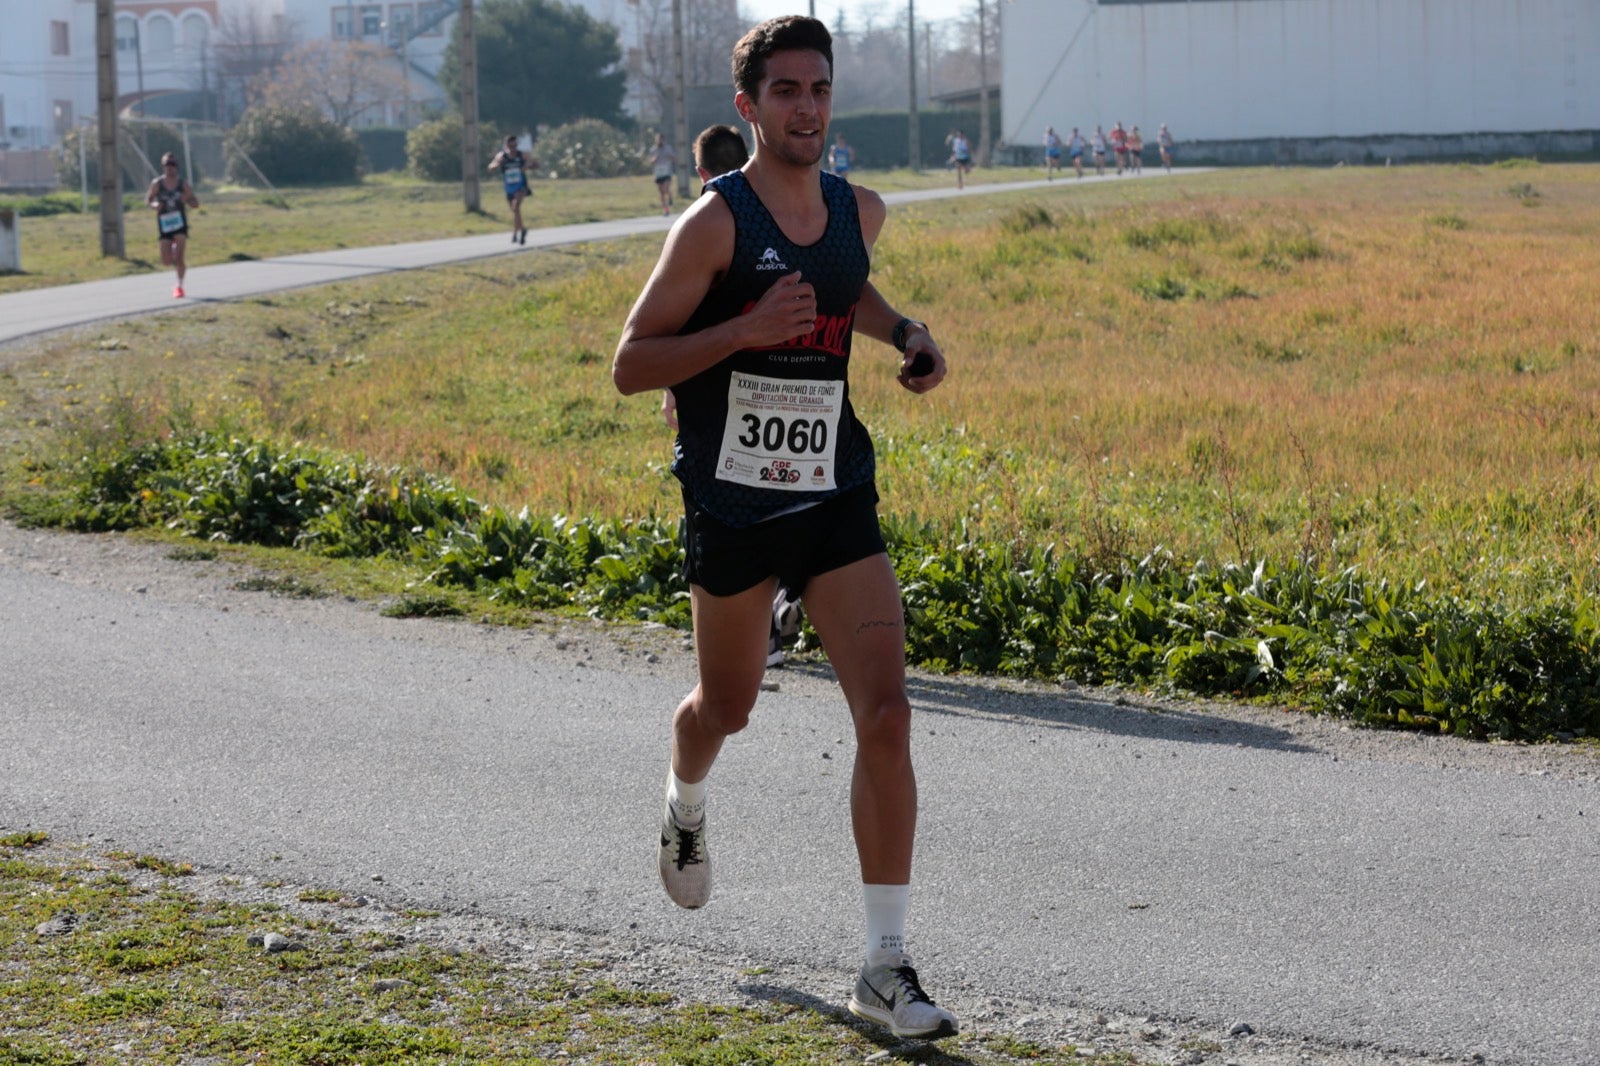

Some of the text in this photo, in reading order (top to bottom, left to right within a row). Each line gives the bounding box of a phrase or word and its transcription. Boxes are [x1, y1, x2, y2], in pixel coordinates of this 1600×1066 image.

[768, 354, 826, 363] CLUB DEPORTIVO
[760, 382, 781, 393] GRAN
[782, 384, 808, 395] PREMIO
[809, 385, 818, 395] DE
[789, 395, 797, 403] DE
[799, 395, 824, 404] GRANADA
[738, 413, 828, 454] 3060
